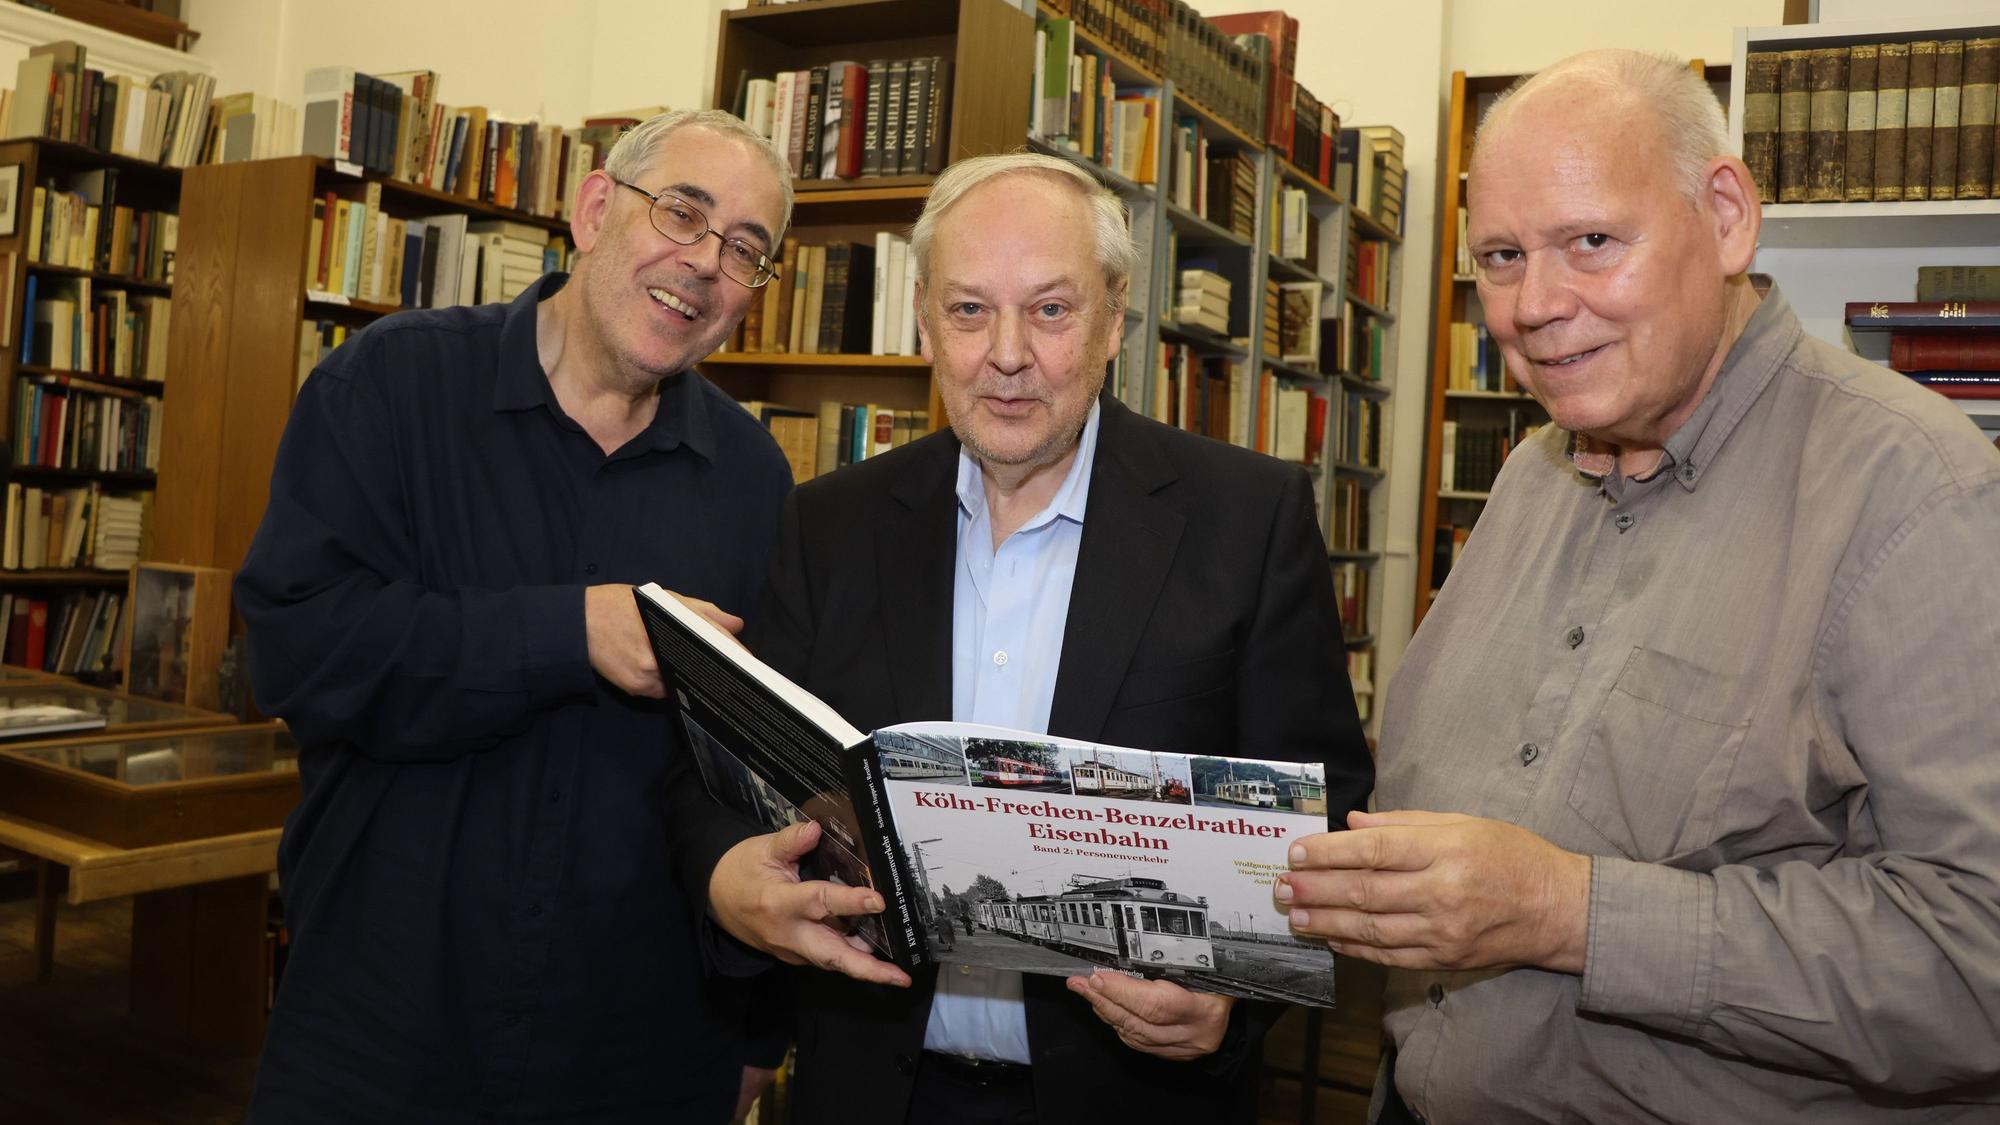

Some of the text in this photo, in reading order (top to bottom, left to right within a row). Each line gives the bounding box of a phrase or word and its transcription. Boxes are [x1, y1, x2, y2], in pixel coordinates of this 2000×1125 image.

[811, 95, 819, 104] III
[865, 79, 881, 150] RICHELIEU
[885, 79, 901, 150] RICHELIEU
[904, 78, 921, 149] RICHELIEU
[806, 105, 818, 152] RICHARD
[913, 791, 1287, 839] Köln-Frechen-Benzelrather
[1027, 823, 1170, 850] Eisenbahn
[882, 835, 903, 898] Personenverkehr
[1033, 844, 1169, 864] Band 2: Personenverkehr
[1233, 860, 1271, 871] Wolfgang
[1238, 869, 1270, 877] Norbert
[899, 903, 910, 923] Band
[906, 926, 916, 947] KFBE
